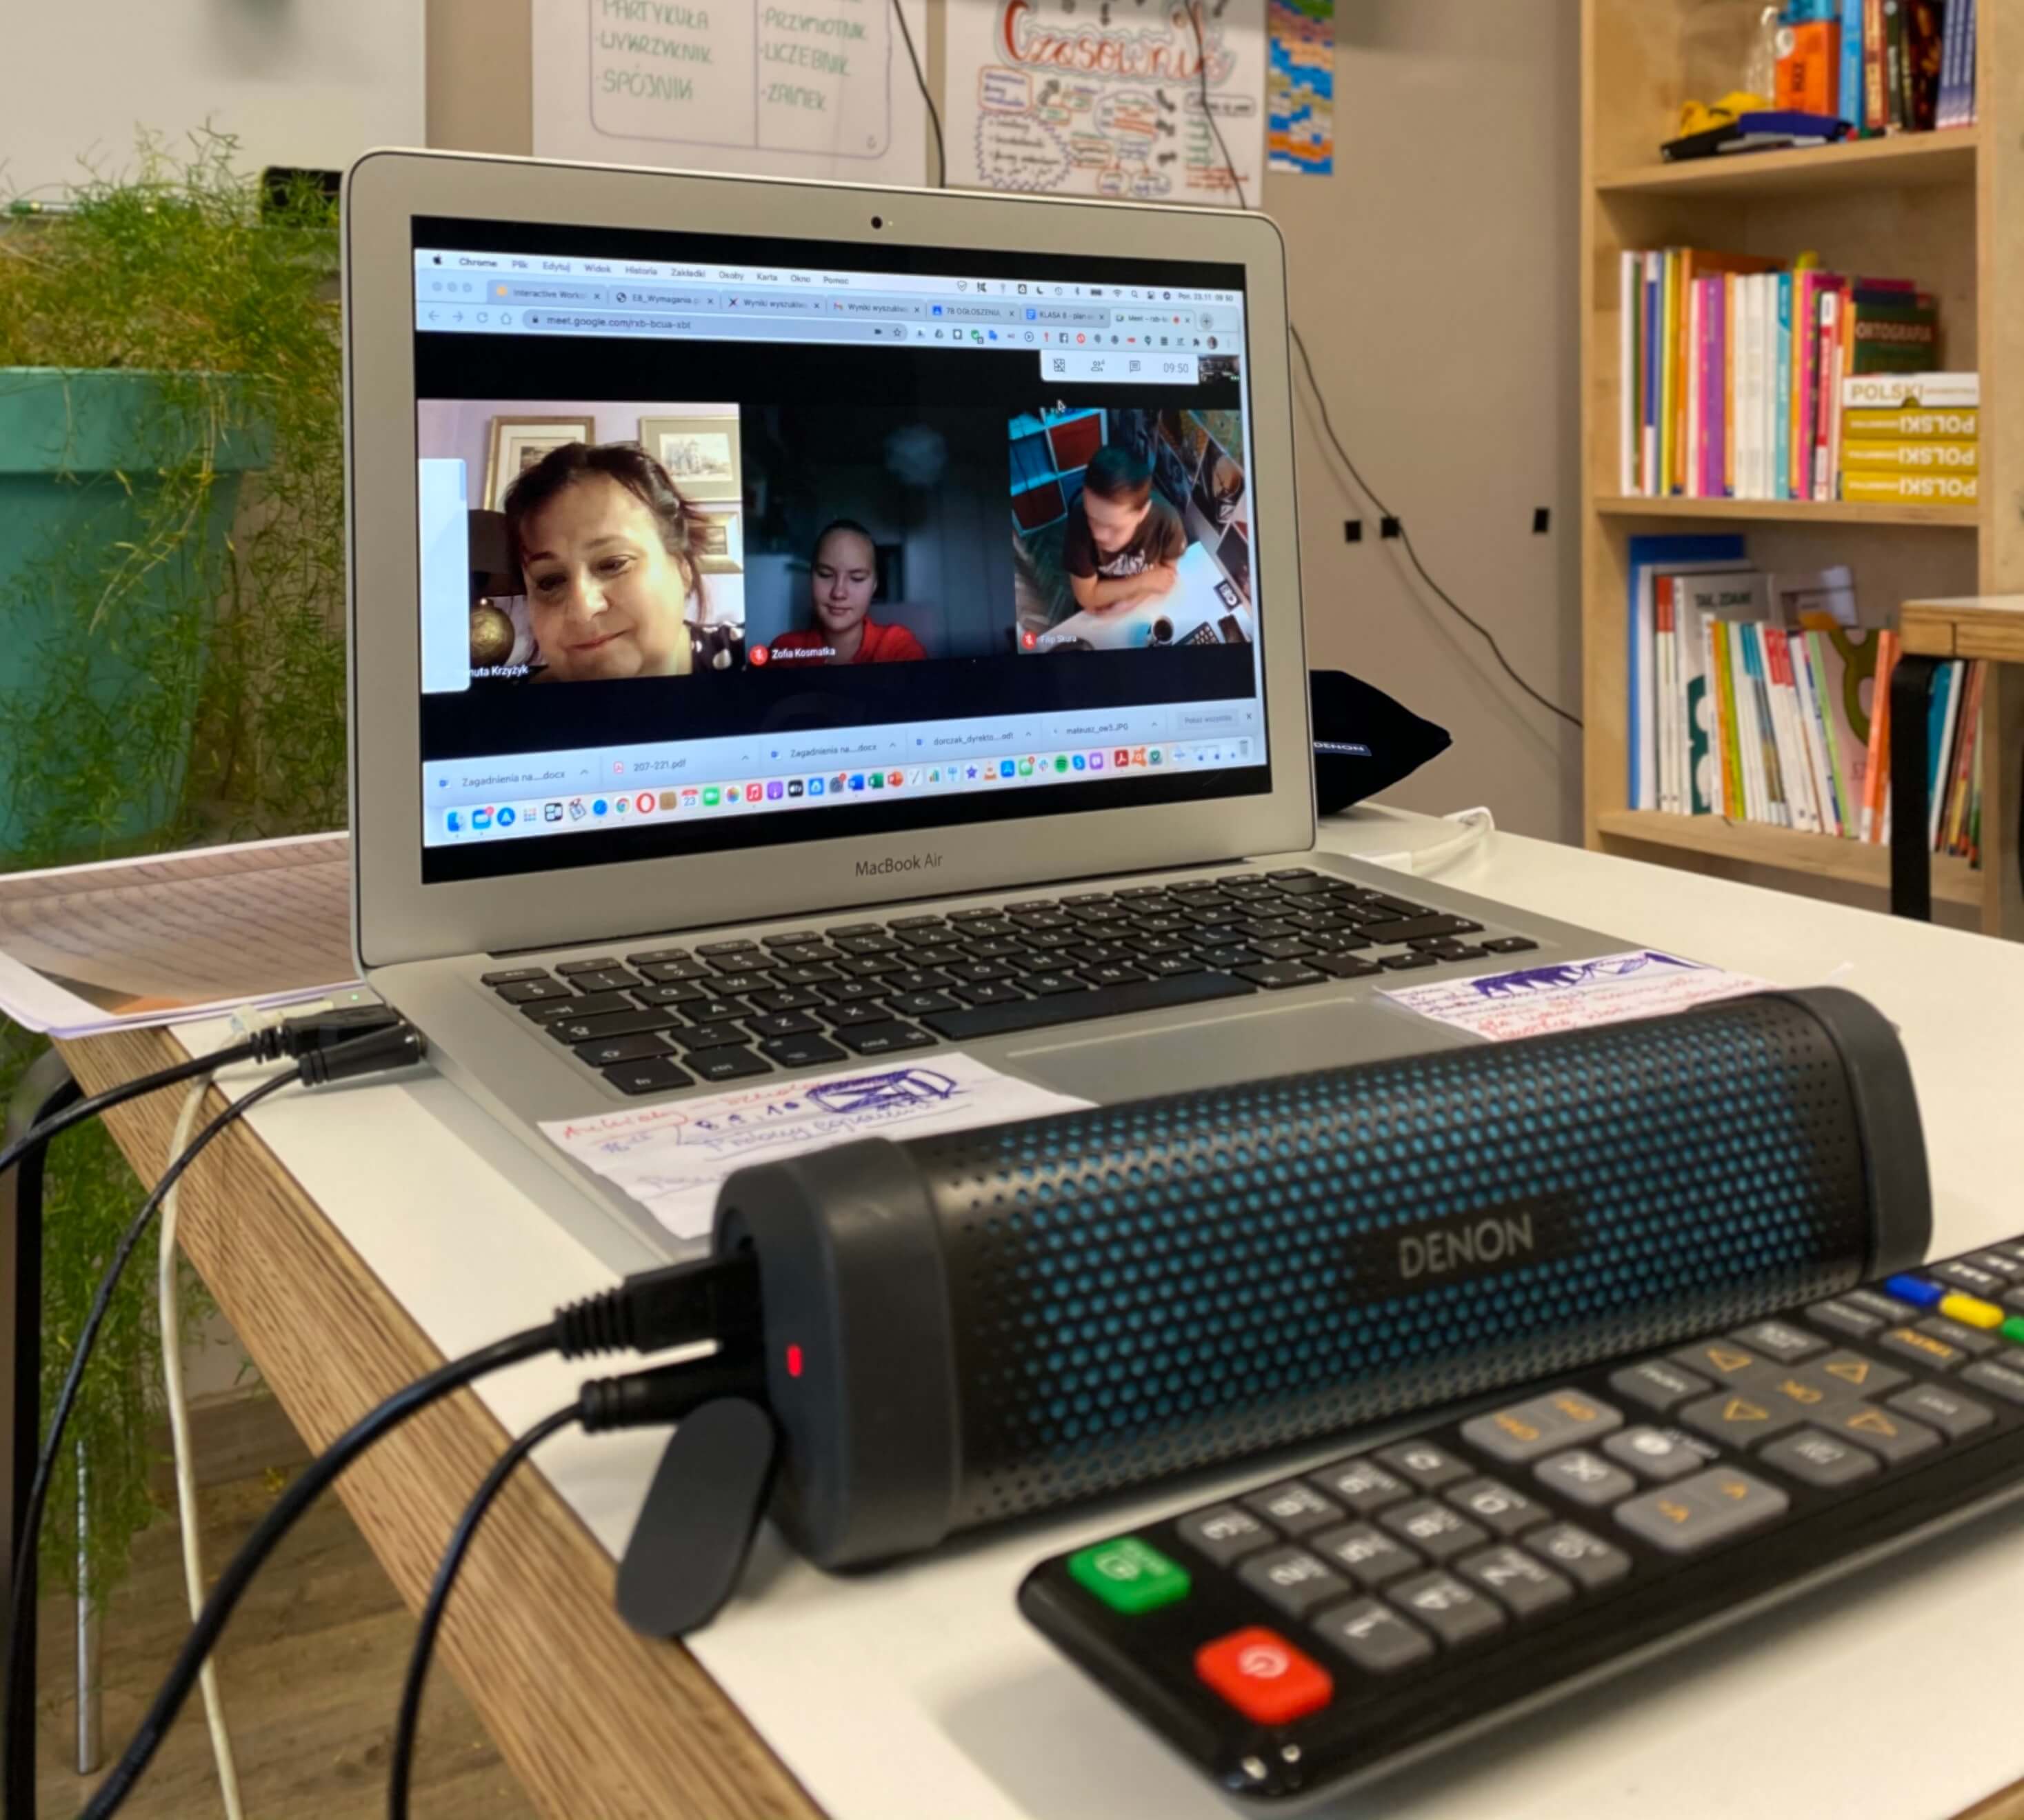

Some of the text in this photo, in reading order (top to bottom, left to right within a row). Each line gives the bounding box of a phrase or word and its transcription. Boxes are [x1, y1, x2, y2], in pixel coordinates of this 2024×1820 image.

[459, 258, 849, 285] Chrome Plik Edytuj Widok Historia Zakładki Osoby Karta Okno Pomoc
[1163, 362, 1189, 373] 09:50
[1851, 383, 1923, 400] POLSKI
[1899, 414, 1976, 434] POLSKI
[1898, 446, 1975, 466] POLSKI
[1898, 476, 1978, 497] POLSKI
[772, 650, 793, 659] Zofia
[491, 664, 529, 677] Krzyżyk
[634, 759, 686, 772] 207-221.pdf
[463, 773, 519, 788] Zagadnienia
[683, 797, 696, 806] 23
[855, 852, 943, 877] MacBook Air
[1399, 1211, 1533, 1279] DENON
